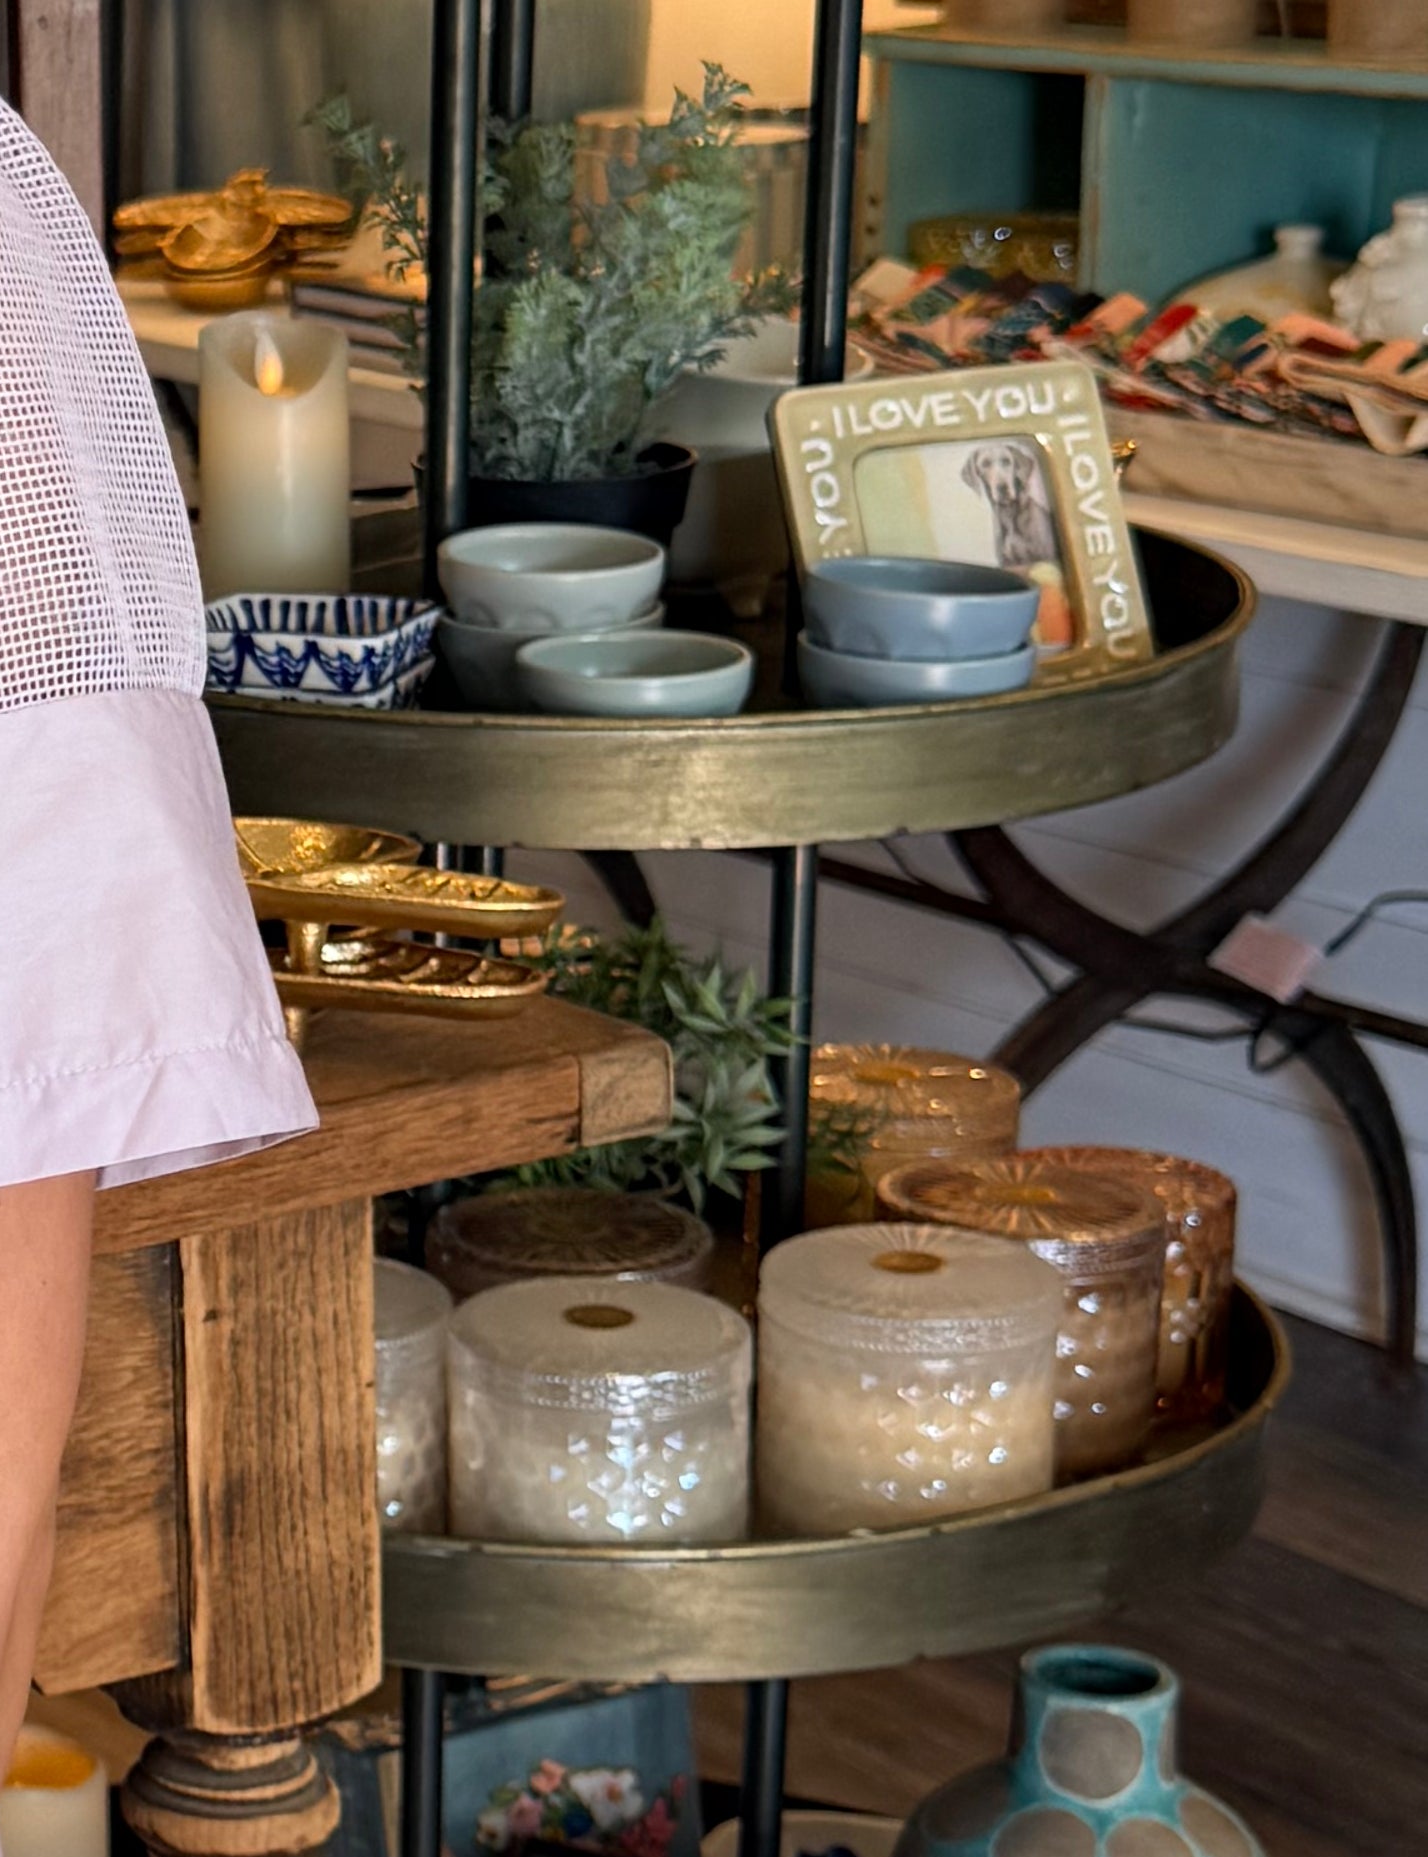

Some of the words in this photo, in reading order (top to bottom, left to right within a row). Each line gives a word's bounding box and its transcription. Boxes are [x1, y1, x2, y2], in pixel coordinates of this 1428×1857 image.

[831, 405, 844, 439] I
[847, 392, 962, 436] LOVE
[961, 380, 1055, 424] YOU
[1057, 413, 1089, 428] I
[800, 437, 848, 545] YOU
[1062, 430, 1116, 557] LOVE
[1092, 559, 1139, 660] YOU
